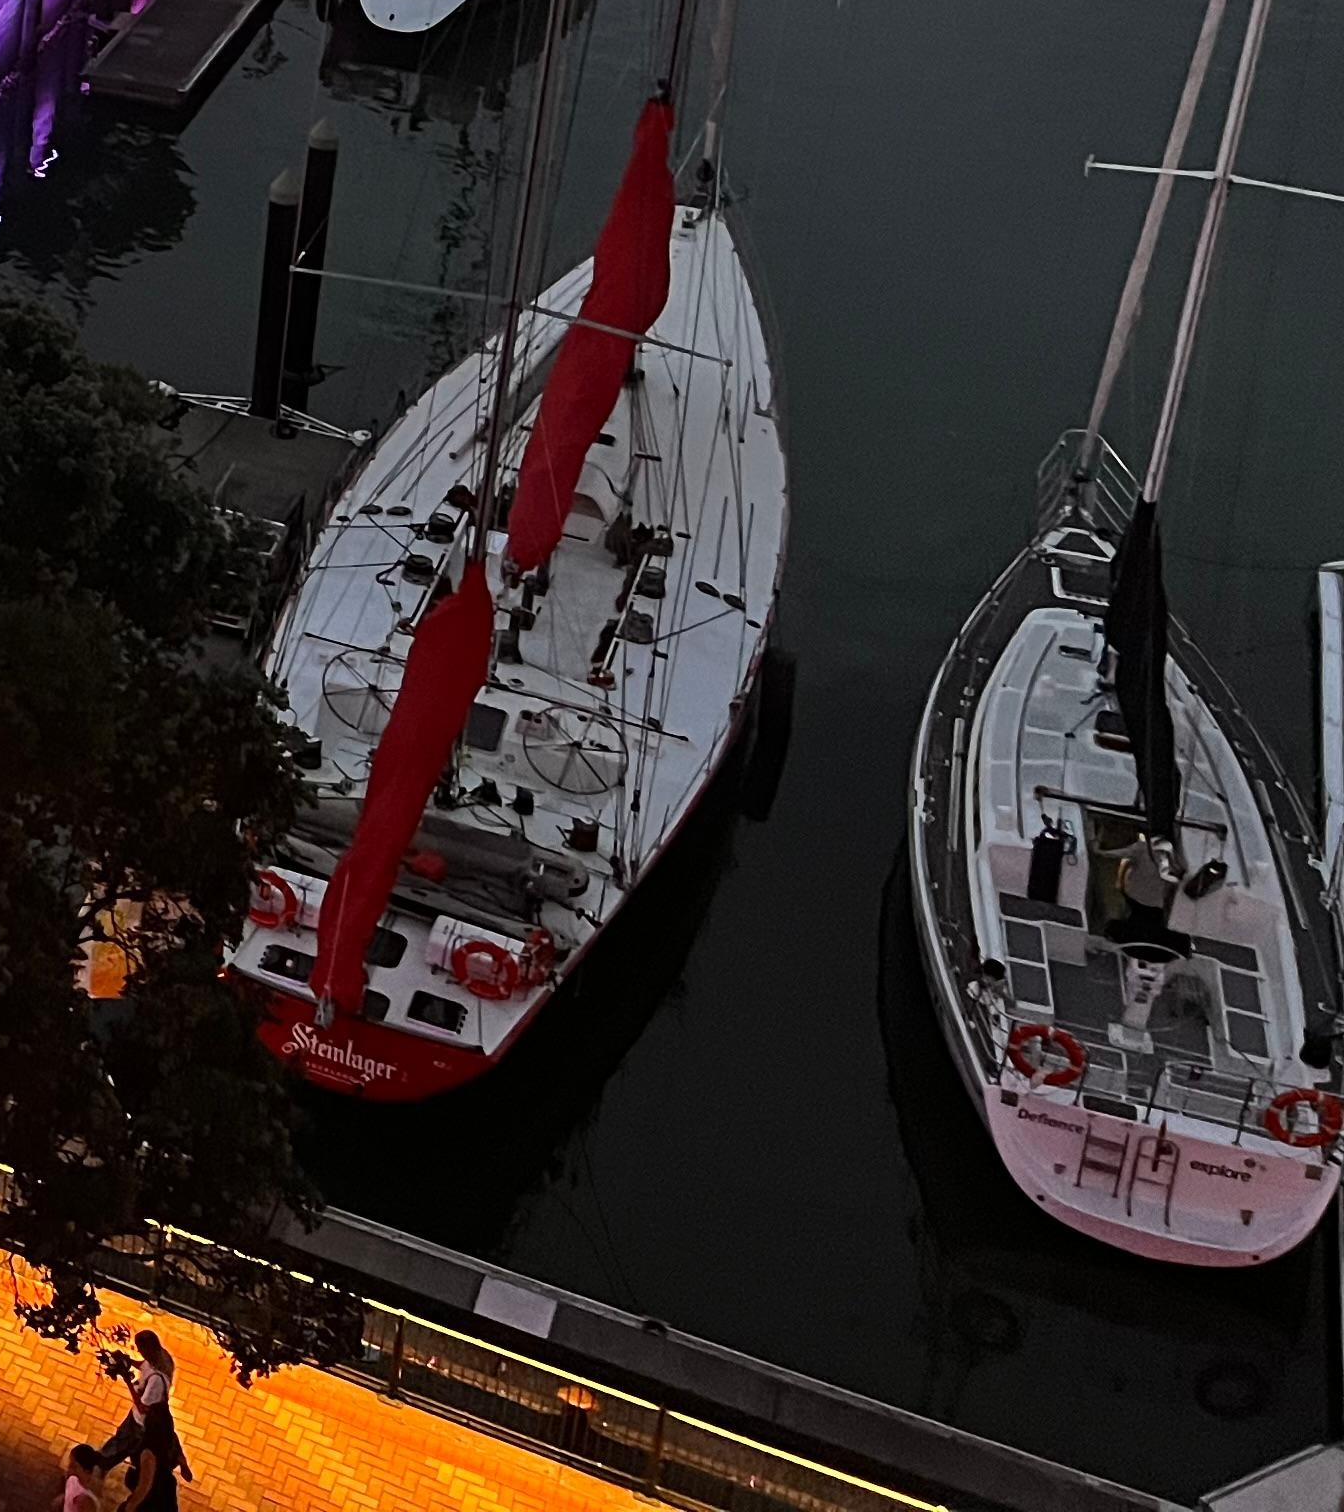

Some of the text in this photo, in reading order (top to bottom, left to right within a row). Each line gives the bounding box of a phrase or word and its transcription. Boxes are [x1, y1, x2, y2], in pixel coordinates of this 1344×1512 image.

[281, 1022, 398, 1083] Steinlager
[1018, 1108, 1085, 1135] Defiance
[1189, 1160, 1252, 1182] explore
